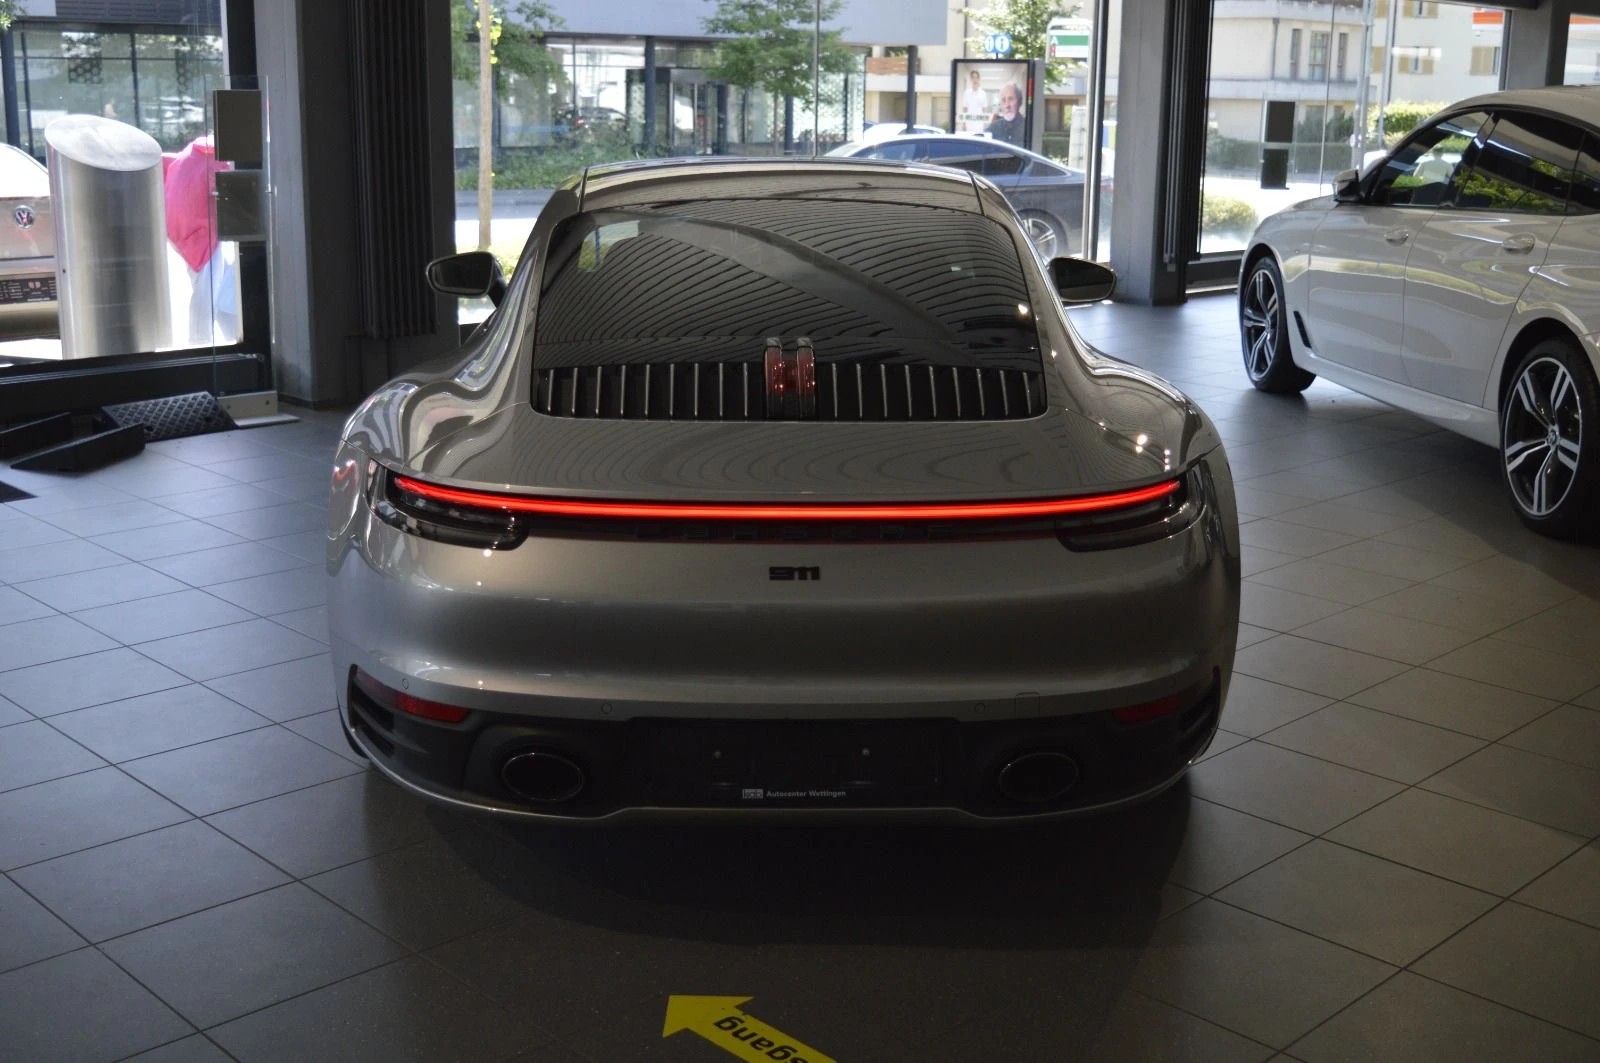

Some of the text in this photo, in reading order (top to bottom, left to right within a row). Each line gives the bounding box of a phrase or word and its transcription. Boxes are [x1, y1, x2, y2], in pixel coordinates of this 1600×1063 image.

[769, 566, 820, 581] 911
[766, 790, 807, 798] Autocenter
[808, 789, 847, 799] Wettingen
